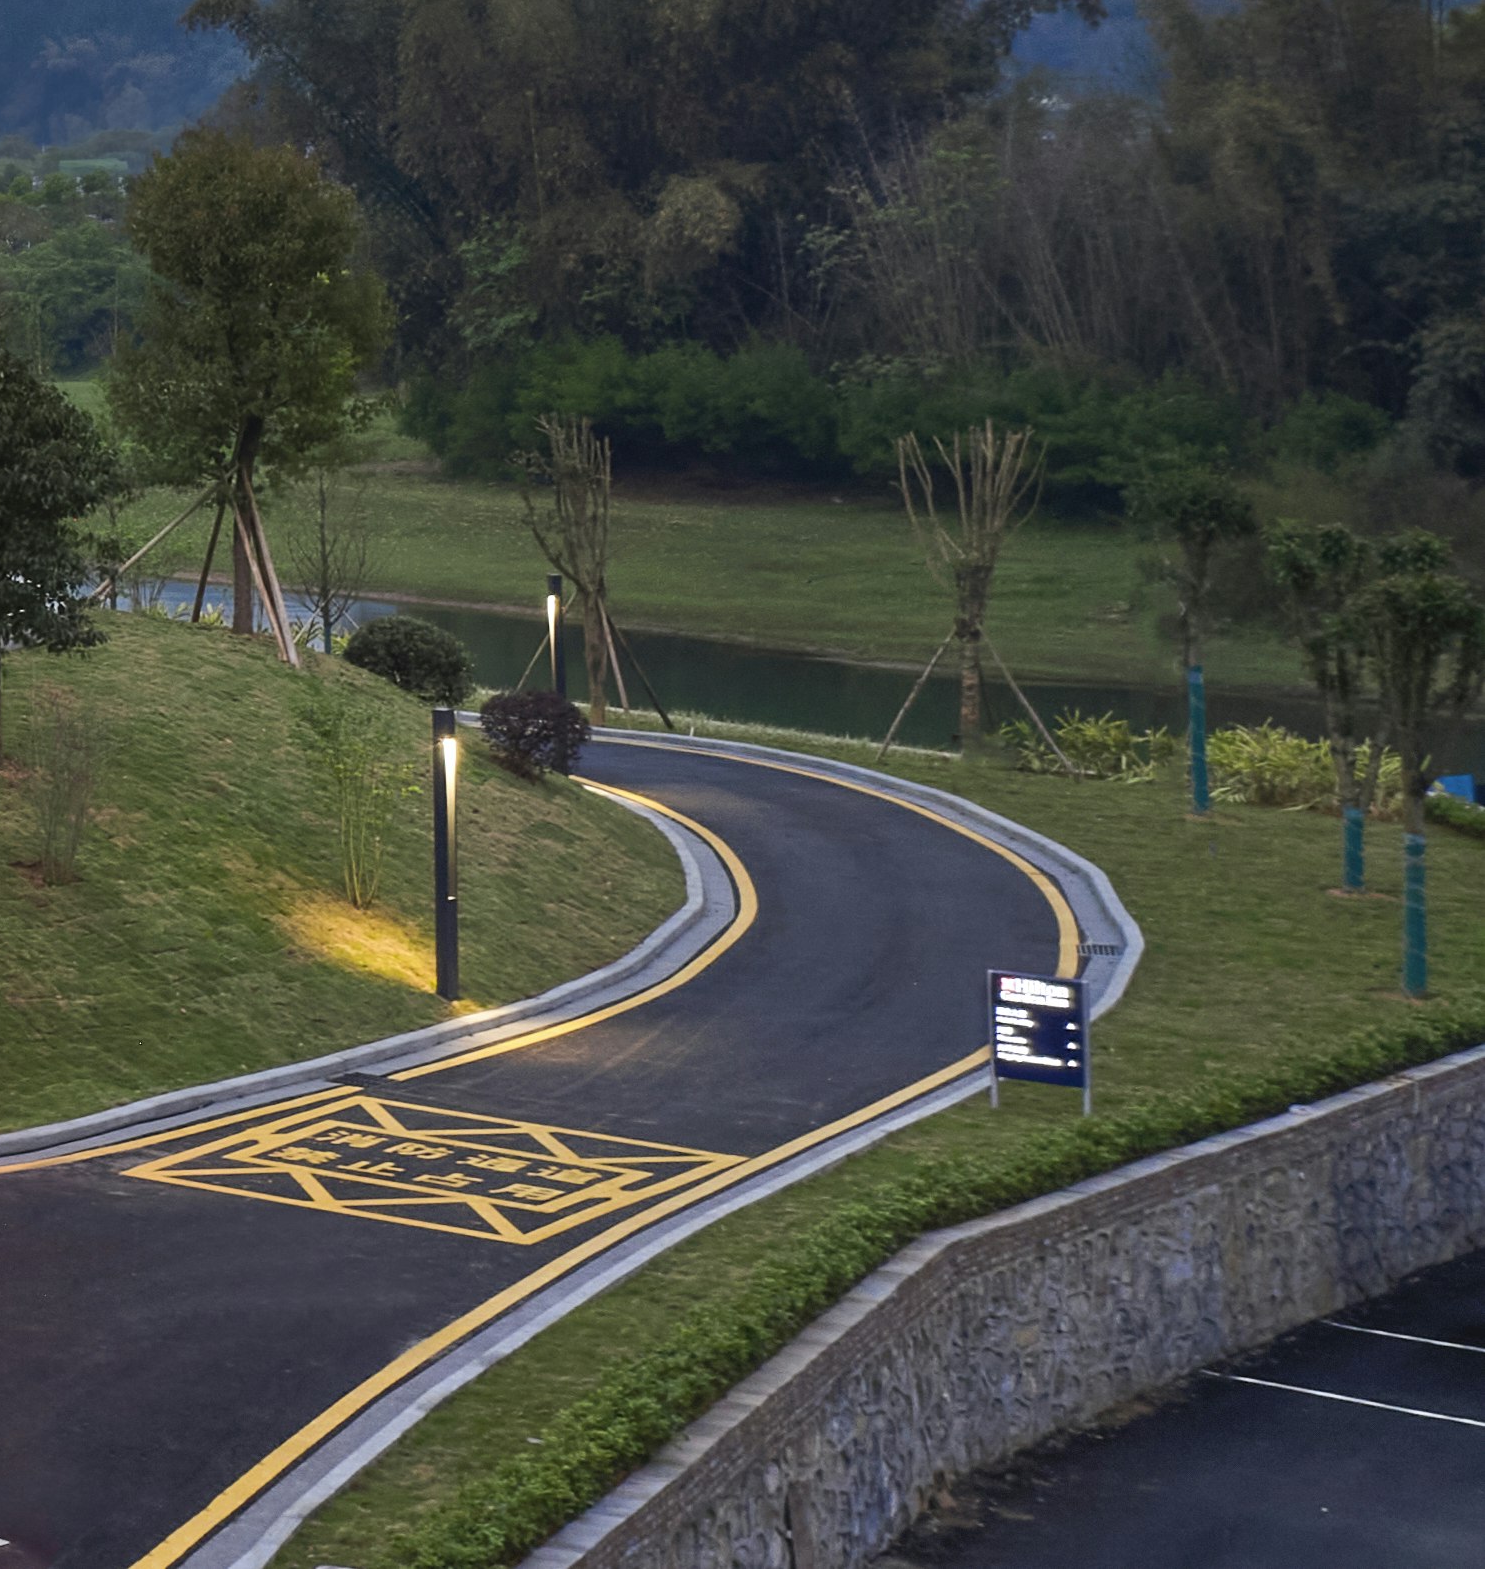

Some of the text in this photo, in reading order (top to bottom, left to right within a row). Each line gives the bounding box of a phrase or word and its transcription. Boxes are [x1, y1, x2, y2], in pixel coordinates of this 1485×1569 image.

[269, 1146, 567, 1201] 禁止占用
[315, 1130, 603, 1184] 消防通道
